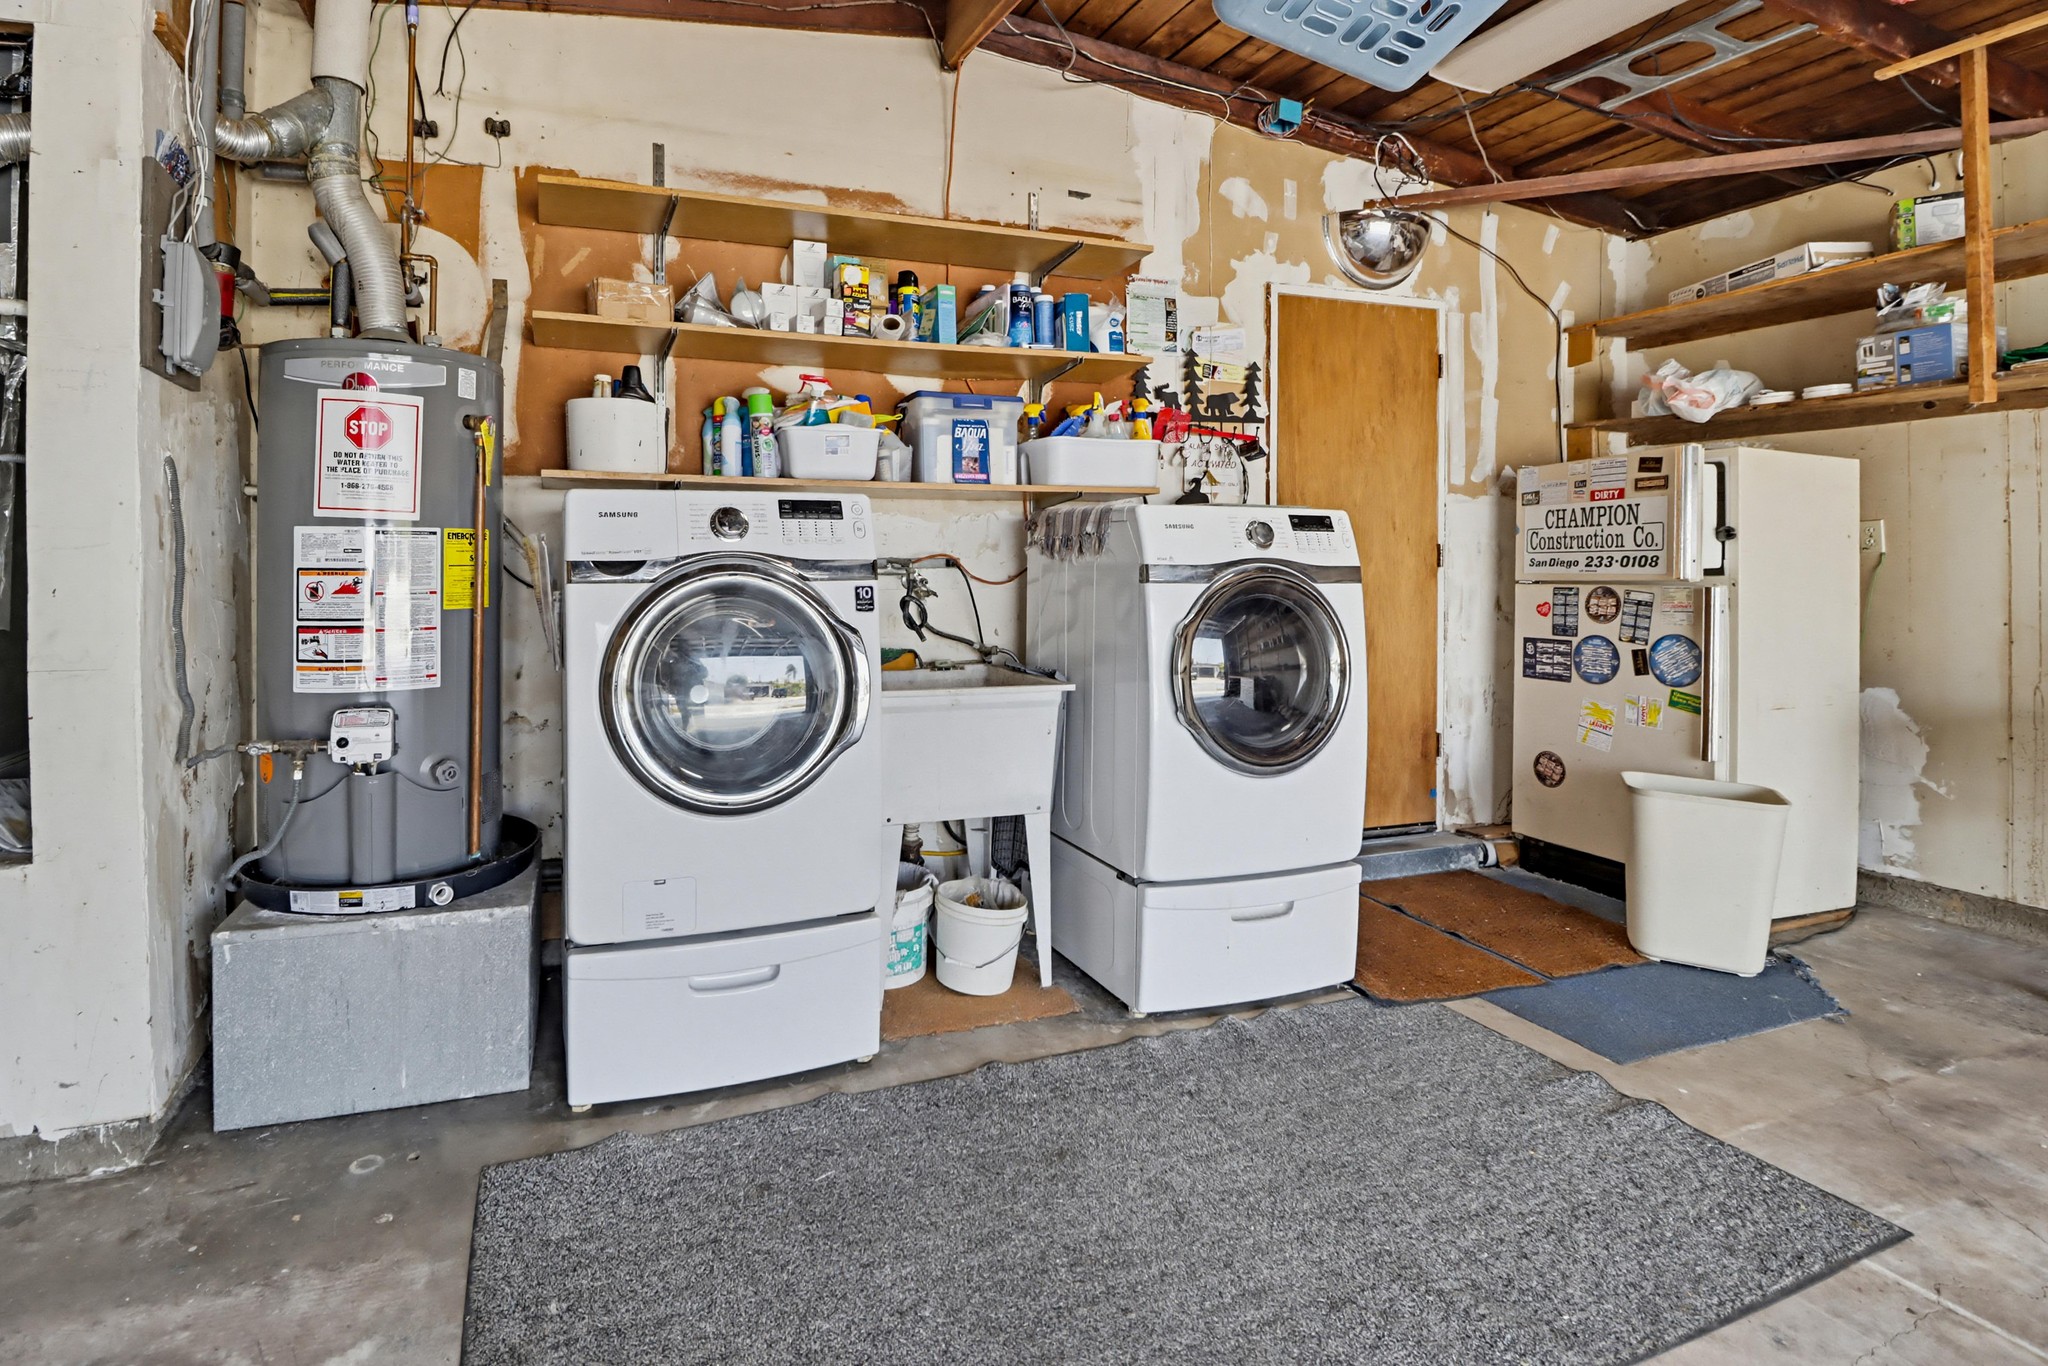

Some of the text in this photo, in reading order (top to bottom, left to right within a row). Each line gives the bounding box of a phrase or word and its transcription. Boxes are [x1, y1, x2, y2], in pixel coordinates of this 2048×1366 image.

[349, 419, 389, 437] STOP
[954, 427, 987, 439] BAQUA
[333, 451, 343, 459] DO
[340, 466, 361, 474] PLACE
[1594, 489, 1620, 500] DIRTY
[1545, 503, 1641, 530] CHAMPION
[1530, 525, 1659, 551] Construction Co.
[856, 587, 872, 599] 10
